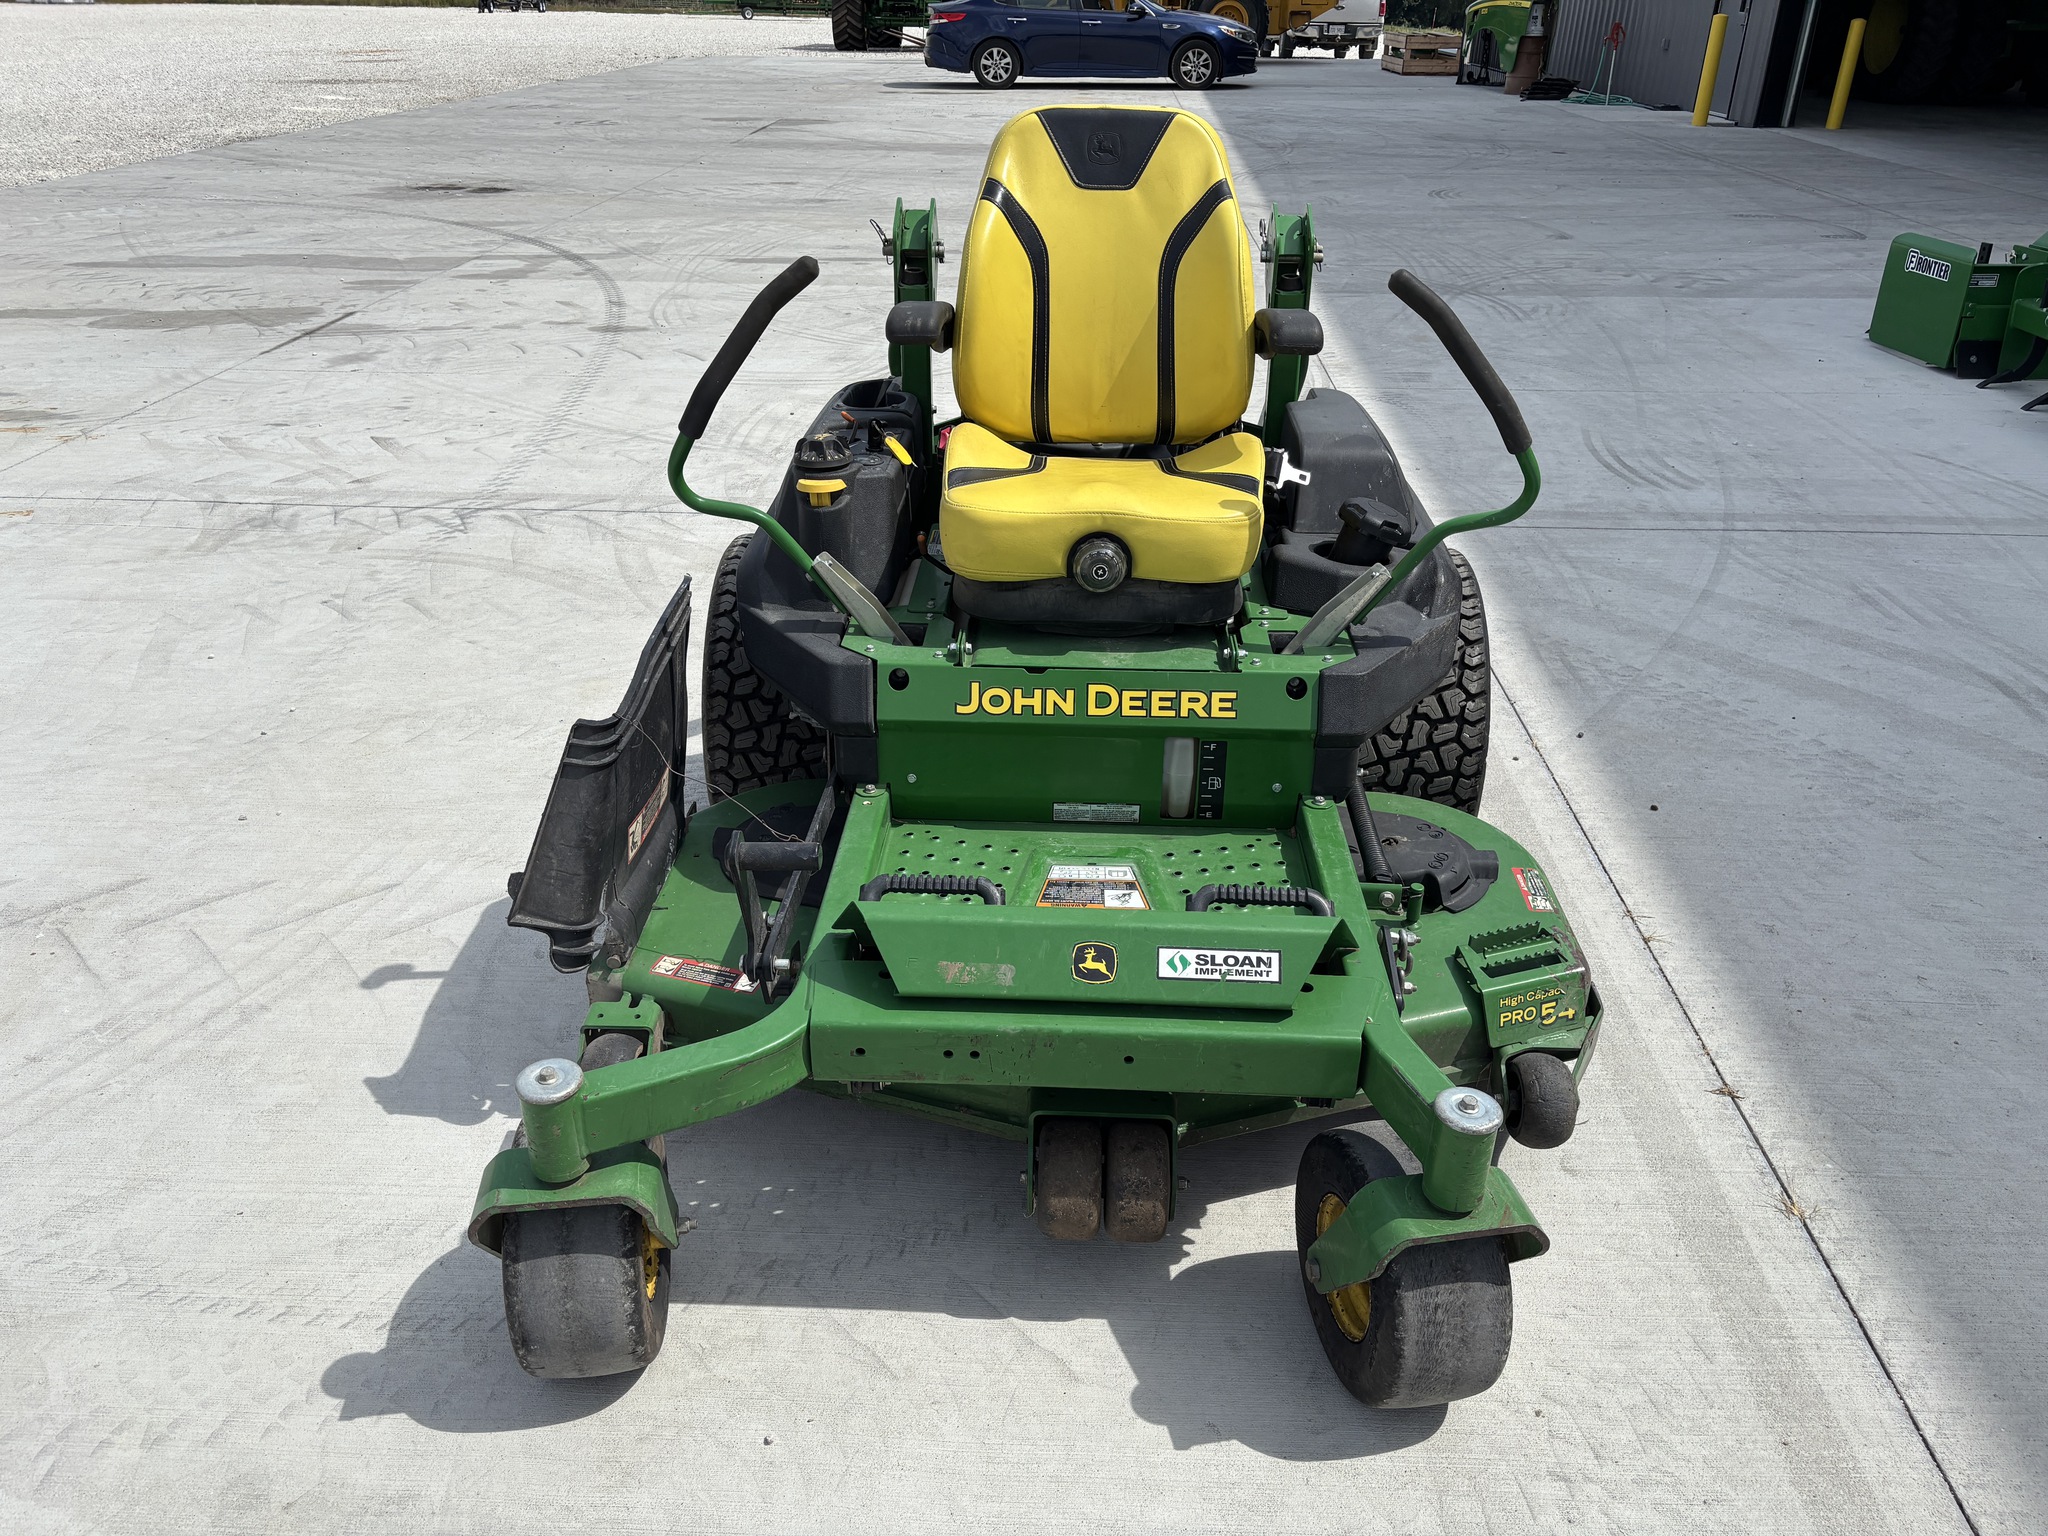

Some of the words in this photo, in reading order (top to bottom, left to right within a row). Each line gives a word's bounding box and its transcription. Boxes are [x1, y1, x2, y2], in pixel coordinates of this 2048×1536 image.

[1906, 250, 1950, 281] FRONTIER
[955, 681, 1075, 716] JOHN
[1086, 683, 1238, 719] DEERE
[1210, 743, 1217, 751] F
[1195, 953, 1272, 969] SLOAN
[1499, 994, 1525, 1008] High
[1499, 1006, 1537, 1027] PRO
